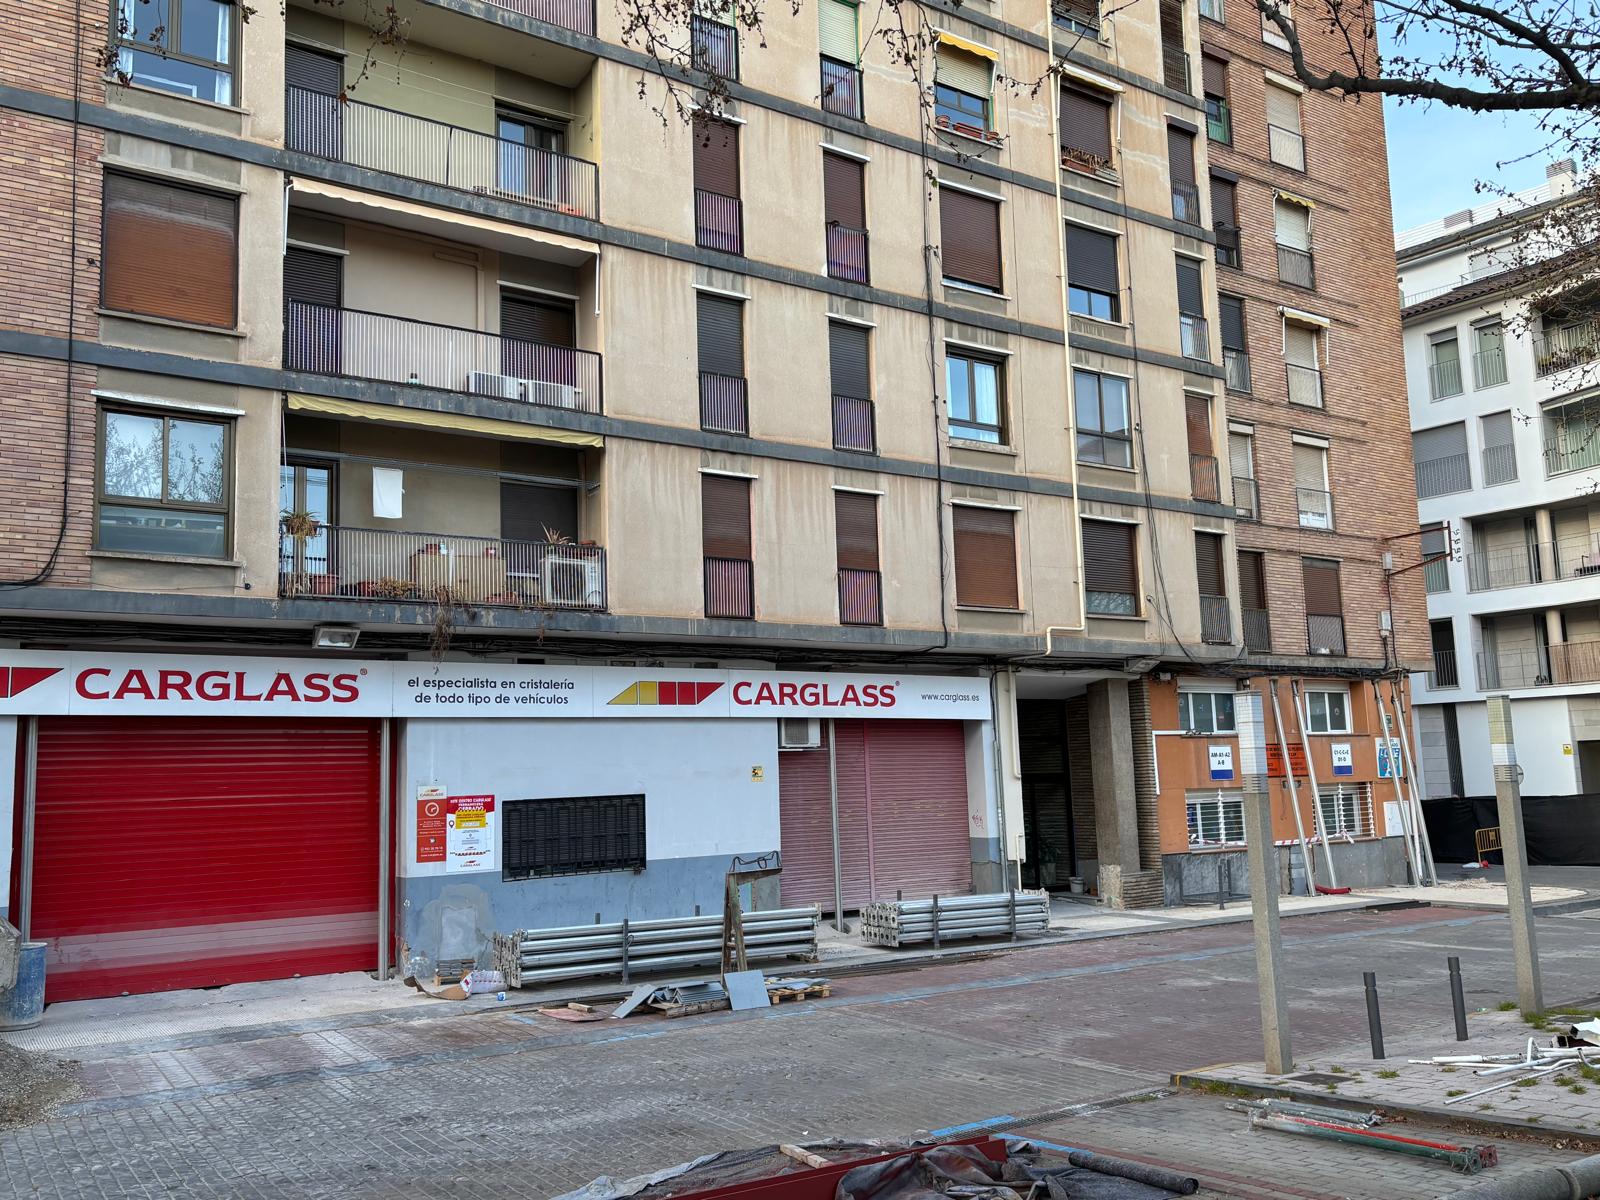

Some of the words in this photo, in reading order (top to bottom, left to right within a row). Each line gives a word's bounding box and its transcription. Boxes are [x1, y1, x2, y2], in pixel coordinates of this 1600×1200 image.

[75, 668, 360, 703] CARGLASS
[408, 677, 419, 688] el
[423, 678, 497, 690] especialista
[500, 680, 516, 689] en
[519, 678, 575, 690] cristalería
[414, 692, 432, 704] de
[435, 693, 466, 704] todo
[468, 693, 492, 706] tipo
[494, 693, 511, 704] de
[513, 693, 569, 705] vehículos
[732, 681, 897, 708] CARGLASS
[921, 692, 980, 703] www.carglass.es
